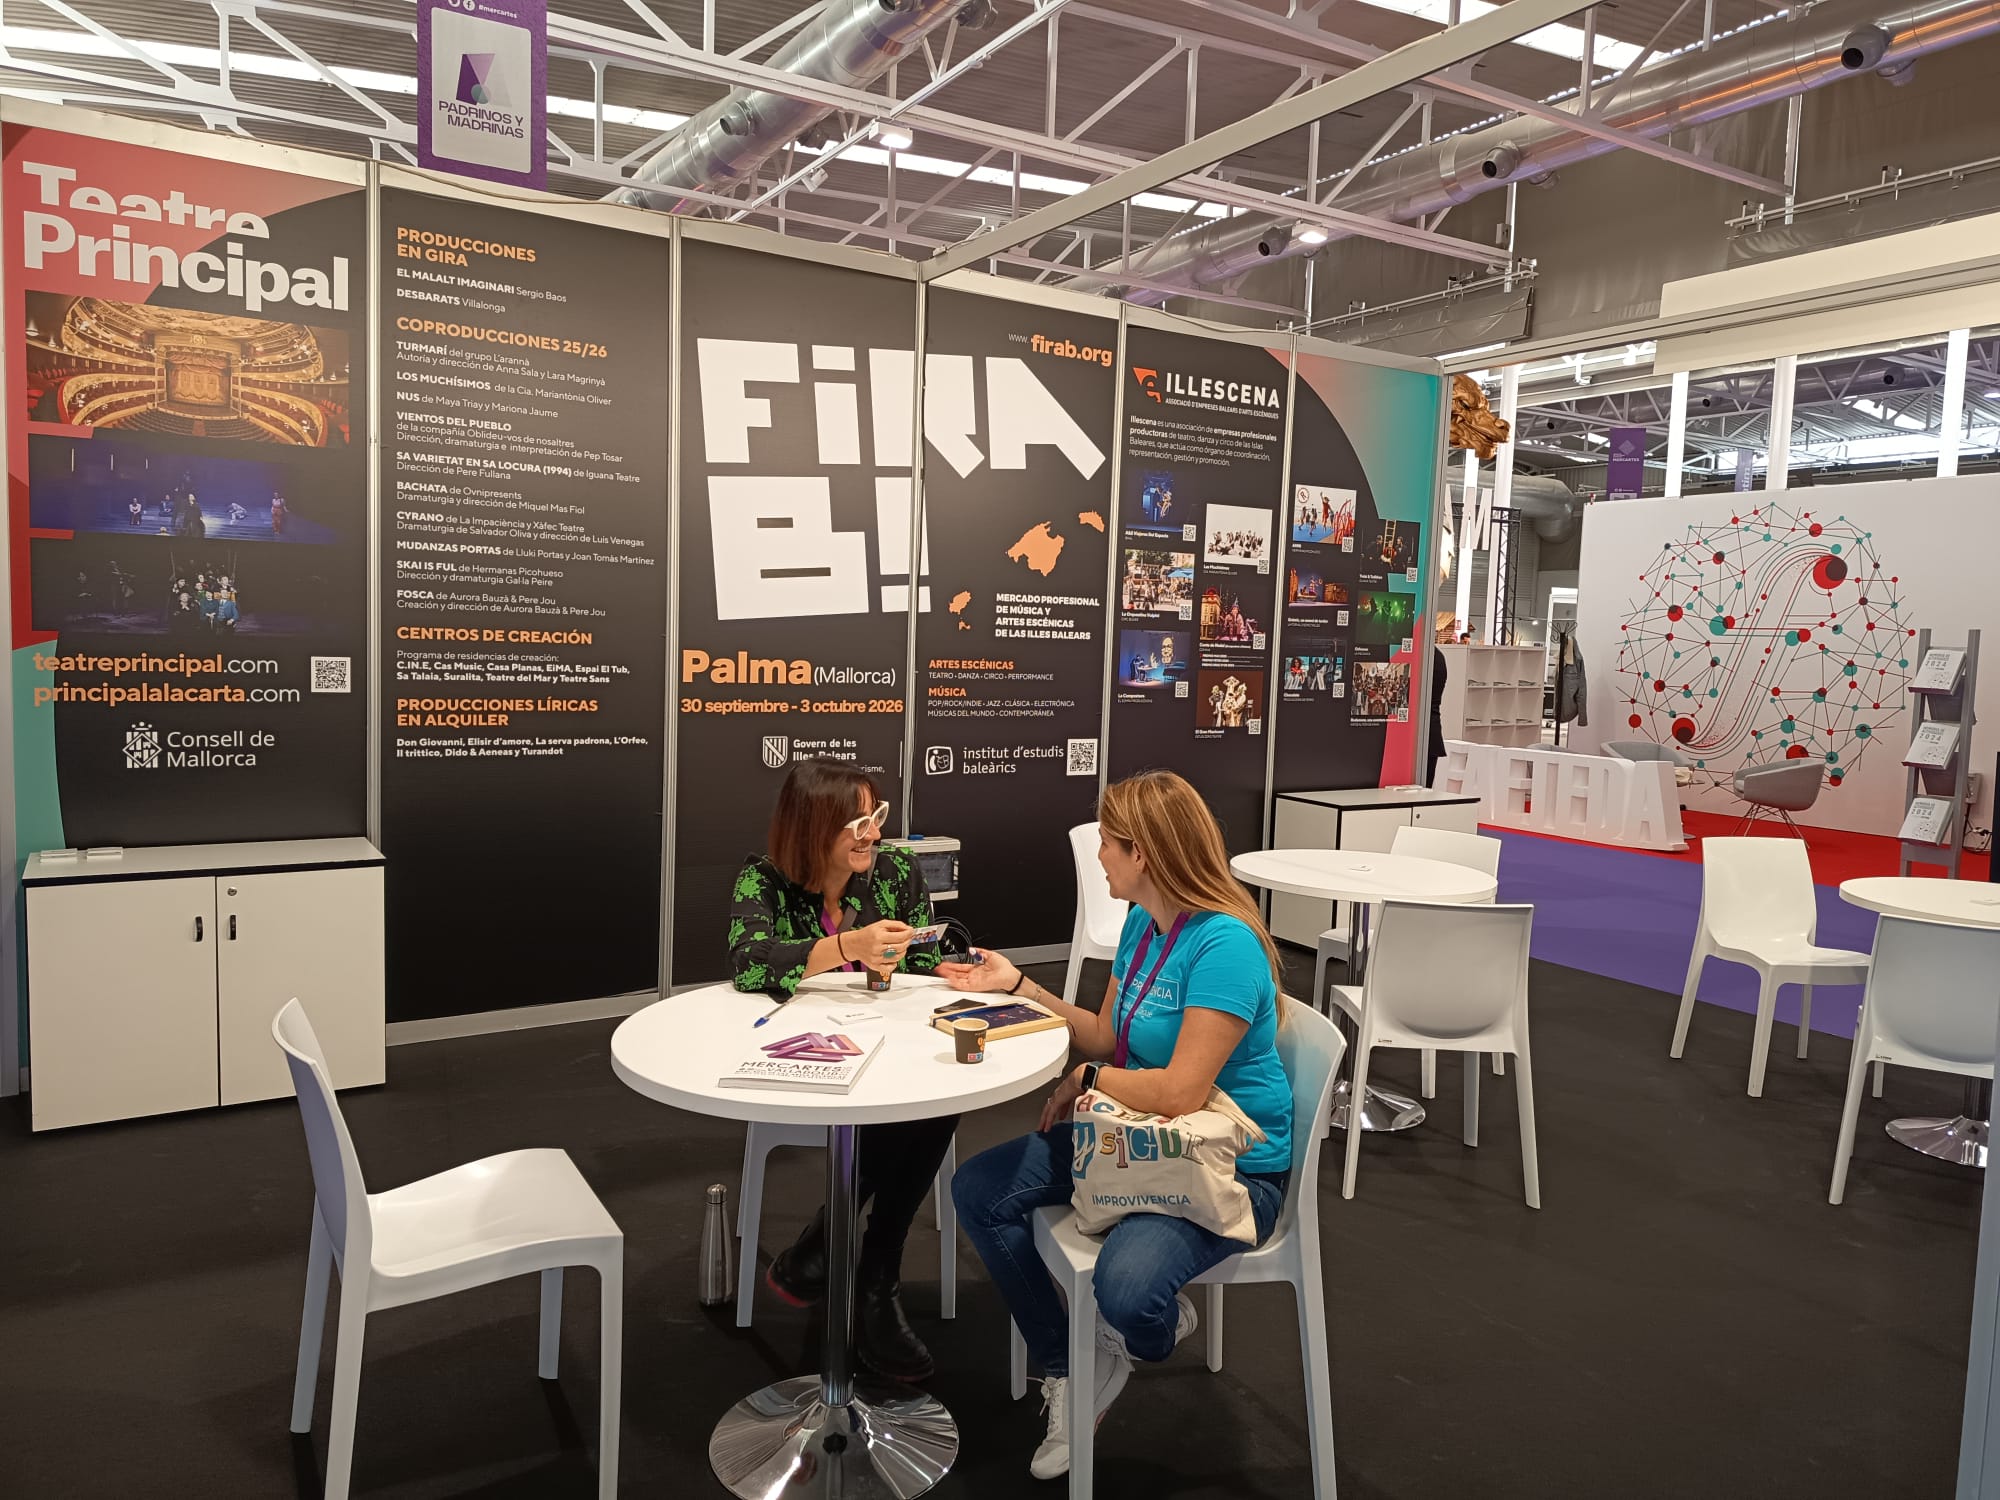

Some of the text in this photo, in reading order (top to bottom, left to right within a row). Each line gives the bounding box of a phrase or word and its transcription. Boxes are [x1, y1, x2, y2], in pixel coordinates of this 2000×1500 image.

[478, 4, 518, 19] #mercartes
[438, 100, 524, 127] PADRINOS Y
[447, 114, 524, 139] MADRINAS
[23, 161, 270, 240] Teatre
[397, 227, 536, 262] PRODUCCIONES
[23, 210, 349, 312] Principal
[397, 243, 468, 267] EN GIRA
[396, 267, 566, 302] EL MALALT IMAGINARI Sergio Baos
[396, 288, 505, 313] DESBARATS Villalonga
[396, 316, 607, 357] COPRODUCCIONES 25/26
[395, 340, 447, 355] TURMARÍ
[448, 348, 463, 357] del
[464, 351, 492, 362] grupo
[1008, 332, 1113, 368] www. firab.org
[1166, 372, 1280, 409] ILLESCENA
[396, 411, 511, 431] VIENTOS DEL PUEBLO
[1130, 416, 1156, 426] Illescena
[1175, 423, 1206, 432] asociación
[1213, 428, 1240, 436] empresas
[1240, 431, 1277, 441] profesionales
[1130, 427, 1167, 438] productoras
[1197, 435, 1214, 443] danza
[1156, 441, 1169, 449] que
[1186, 445, 1203, 453] como
[1224, 448, 1233, 456] de
[396, 481, 522, 499] BACHATA de Ovnipresents
[396, 589, 434, 599] FOSCA
[435, 591, 448, 600] de
[449, 592, 480, 601] Aurora
[510, 594, 517, 603] &
[518, 595, 538, 604] Pere
[539, 596, 555, 604] Jou
[996, 592, 1099, 606] MERCADO PROFESIONAL
[995, 604, 1051, 615] DE MÚSICA Y
[995, 616, 1074, 628] ARTES ESCÉNICAS
[396, 626, 592, 644] CENTROS DE CREACIÓN
[995, 628, 1091, 640] DE LAS ILLES BALEARS
[33, 652, 279, 677] teatreprincipal.com
[433, 661, 452, 670] Cas
[453, 662, 484, 671] Music,
[486, 662, 509, 671] Casa
[511, 663, 544, 672] Planas,
[575, 664, 599, 674] Espai
[600, 665, 609, 673] El
[610, 665, 630, 674] Tub,
[682, 649, 896, 687] Palma (Mallorca)
[928, 658, 1014, 670] ARTES ESCÉNICAS
[928, 671, 953, 679] TEATRO
[33, 682, 300, 707] principalalacarta.com
[928, 685, 966, 696] MÚSICA
[397, 696, 598, 711] PRODUCCIONES LÍRICAS
[680, 698, 702, 712] 30
[704, 698, 789, 715] septiembre
[799, 699, 810, 712] 3
[812, 699, 866, 712] octubre
[868, 699, 903, 712] 2026
[1004, 699, 1030, 707] CLÁSICA
[397, 713, 508, 728] EN ALQUILER
[927, 708, 957, 717] MÚSICAS
[167, 730, 275, 747] Consell de
[396, 738, 417, 746] Don
[418, 737, 465, 746] Giovanni,
[467, 737, 492, 745] Elisir
[535, 737, 546, 745] La
[573, 736, 612, 746] padrona,
[793, 738, 856, 748] Govern de les
[167, 750, 256, 767] Mallorca
[962, 745, 1064, 759] institut d'estudis
[963, 761, 1016, 775] baleàrics
[741, 1061, 842, 1072] MERCARTES
[1092, 1194, 1191, 1207] IMPROVIVENCIA
